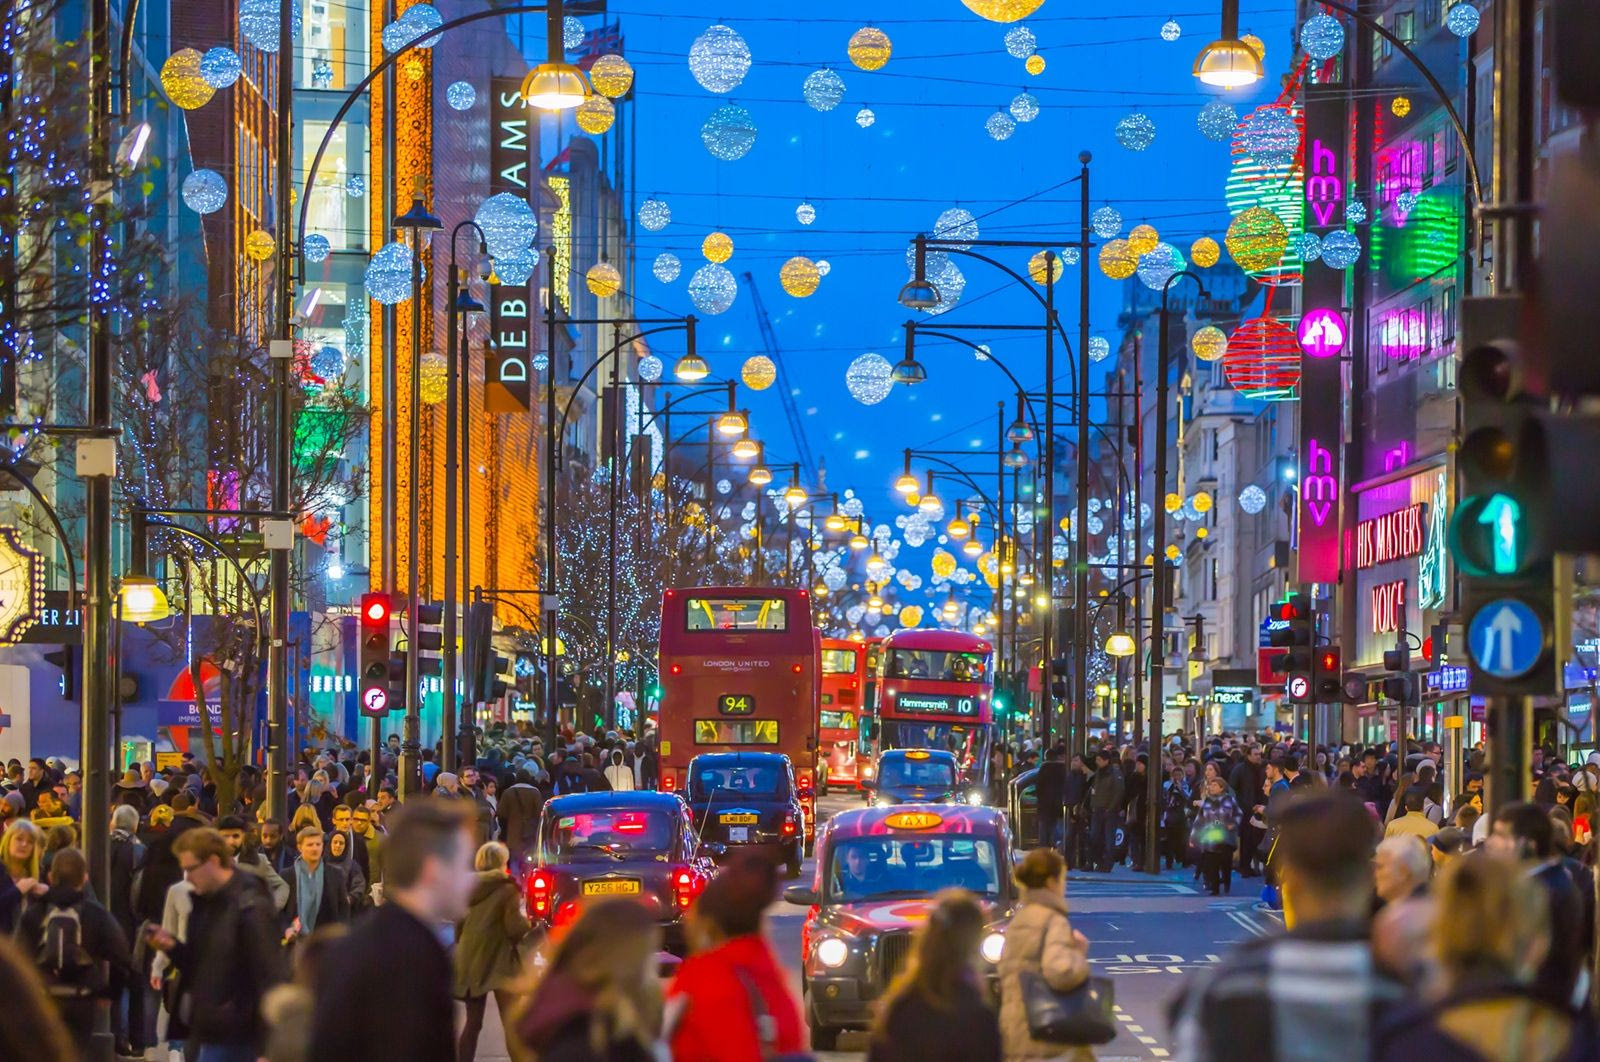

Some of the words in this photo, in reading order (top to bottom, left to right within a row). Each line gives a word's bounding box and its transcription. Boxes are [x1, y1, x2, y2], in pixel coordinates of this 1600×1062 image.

[1306, 139, 1342, 228] hmv
[500, 91, 527, 382] DEBAMS
[1303, 438, 1338, 527] hmv
[1357, 520, 1374, 569] HIS
[65, 609, 79, 625] 21
[1372, 581, 1405, 634] VOICE
[725, 696, 748, 712] 94
[899, 697, 949, 710] Hammersmith
[957, 699, 972, 713] 10
[899, 814, 929, 826] TAXI
[588, 884, 614, 893] Y256
